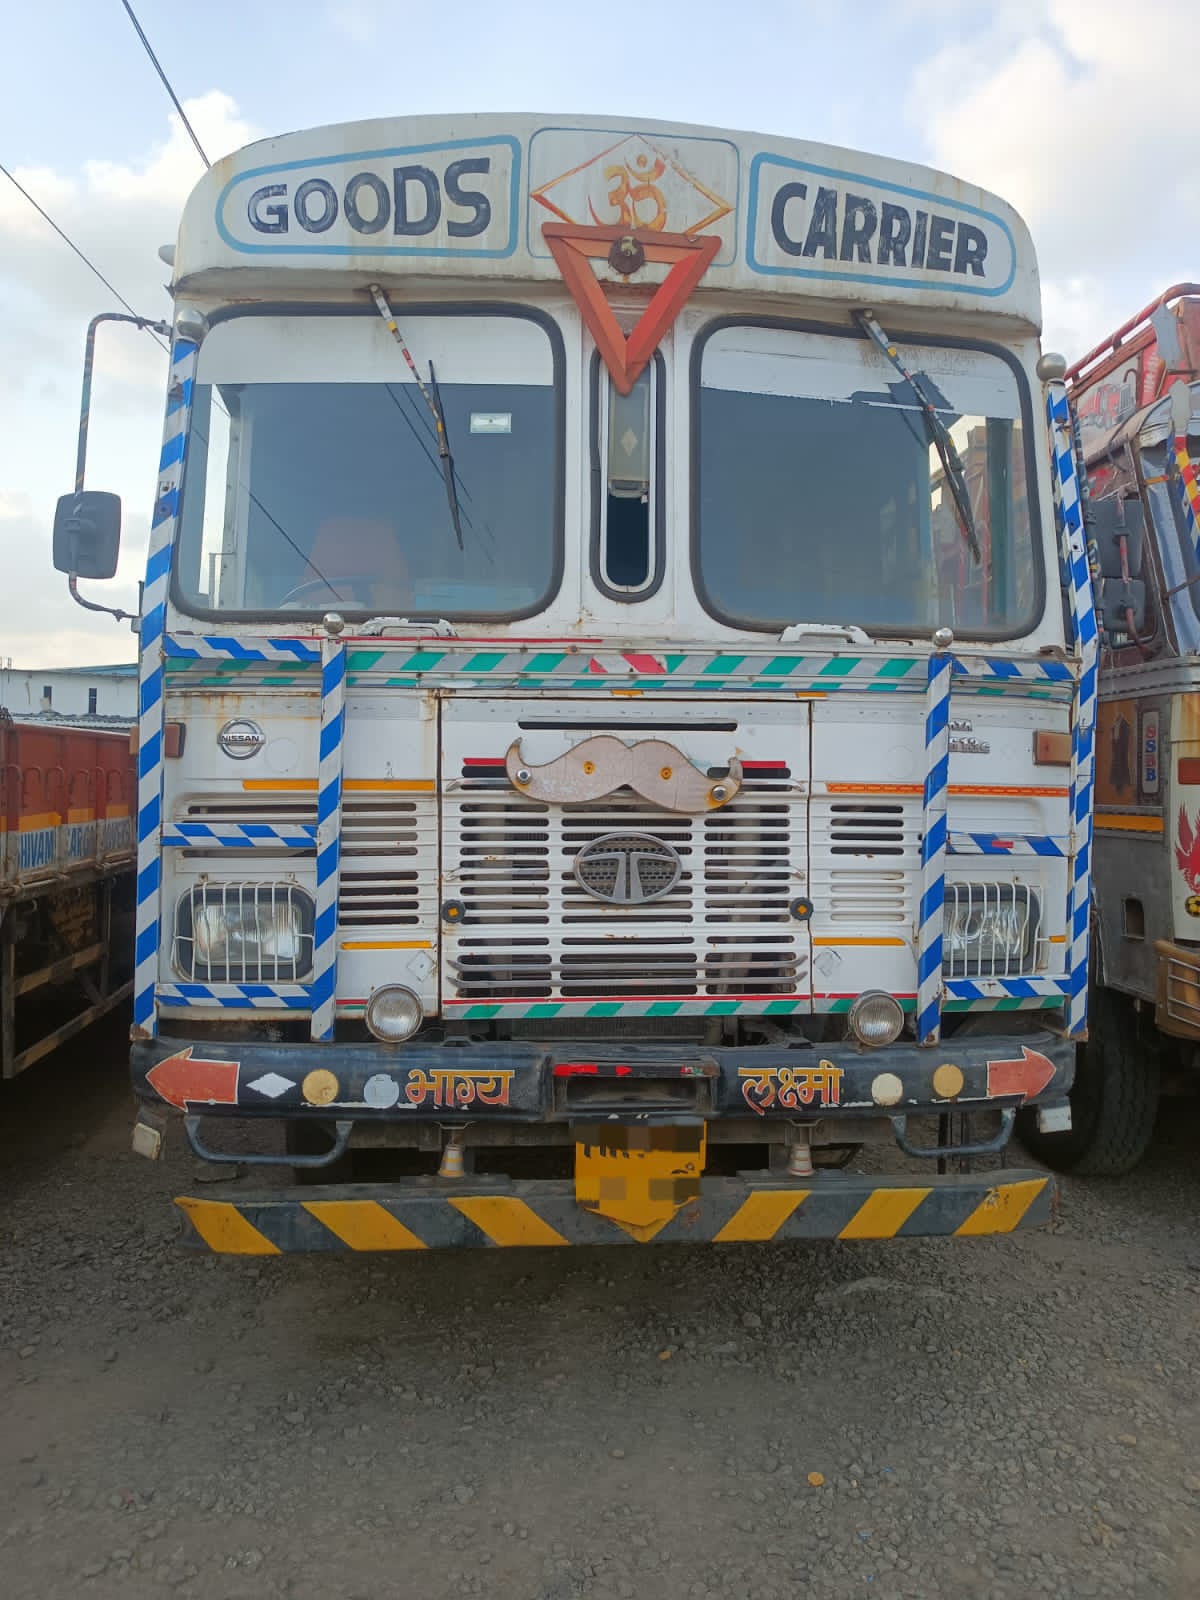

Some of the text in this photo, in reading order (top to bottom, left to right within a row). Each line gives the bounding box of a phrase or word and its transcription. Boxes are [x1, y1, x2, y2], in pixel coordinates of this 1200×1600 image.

[247, 157, 492, 238] GOODS
[770, 182, 989, 278] CARRIER
[220, 734, 261, 743] NISSAN
[405, 1068, 515, 1107] भाग्य
[737, 1059, 845, 1116] लक्ष्मी
